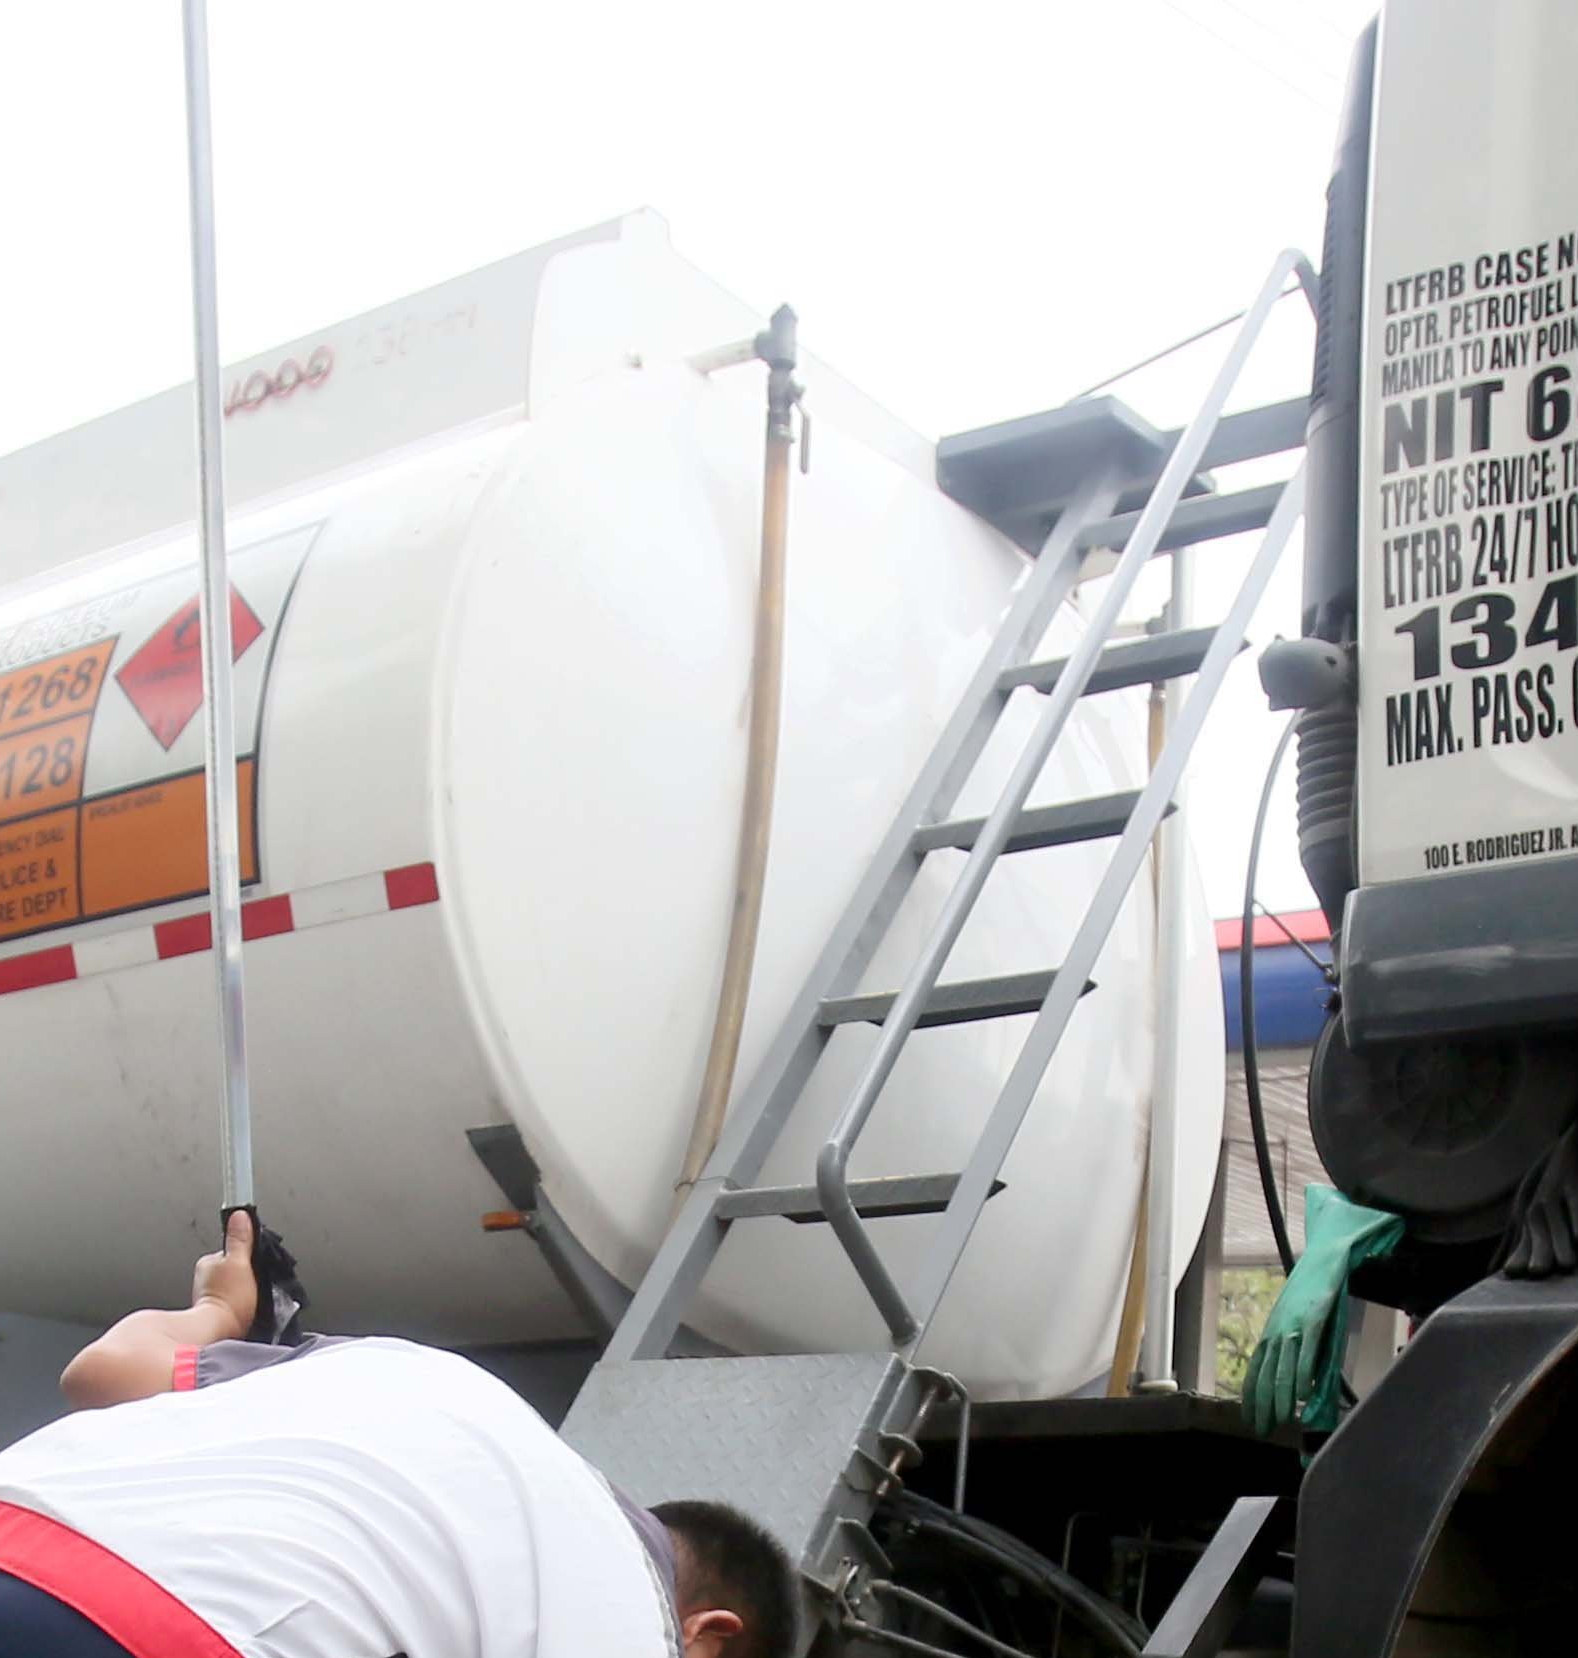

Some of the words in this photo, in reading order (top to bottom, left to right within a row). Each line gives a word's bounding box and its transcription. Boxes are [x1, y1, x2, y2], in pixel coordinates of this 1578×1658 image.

[1386, 264, 1465, 316] LTFRB
[1475, 243, 1549, 289] CASE
[1385, 312, 1443, 356] OPTR.
[1450, 279, 1564, 341] PETROFUEL
[1382, 350, 1455, 398] MANILA
[1460, 339, 1485, 376] TO
[1490, 330, 1531, 371] ANY
[1383, 379, 1504, 476] NIT
[1381, 475, 1428, 530] TYPE
[1434, 466, 1459, 517] OF
[1462, 447, 1556, 511] SERVICE:
[1382, 522, 1464, 610] LTFRB
[1471, 506, 1538, 589] 24/7
[1385, 683, 1464, 768] MAX.
[1472, 662, 1563, 750] PASS.
[0, 737, 76, 800] 128
[45, 857, 56, 879] &
[1424, 845, 1449, 869] 100
[1452, 843, 1463, 866] E.
[1466, 829, 1544, 863] RODRIGUEZ
[1548, 827, 1567, 850] JR.
[21, 887, 67, 918] DEPT
